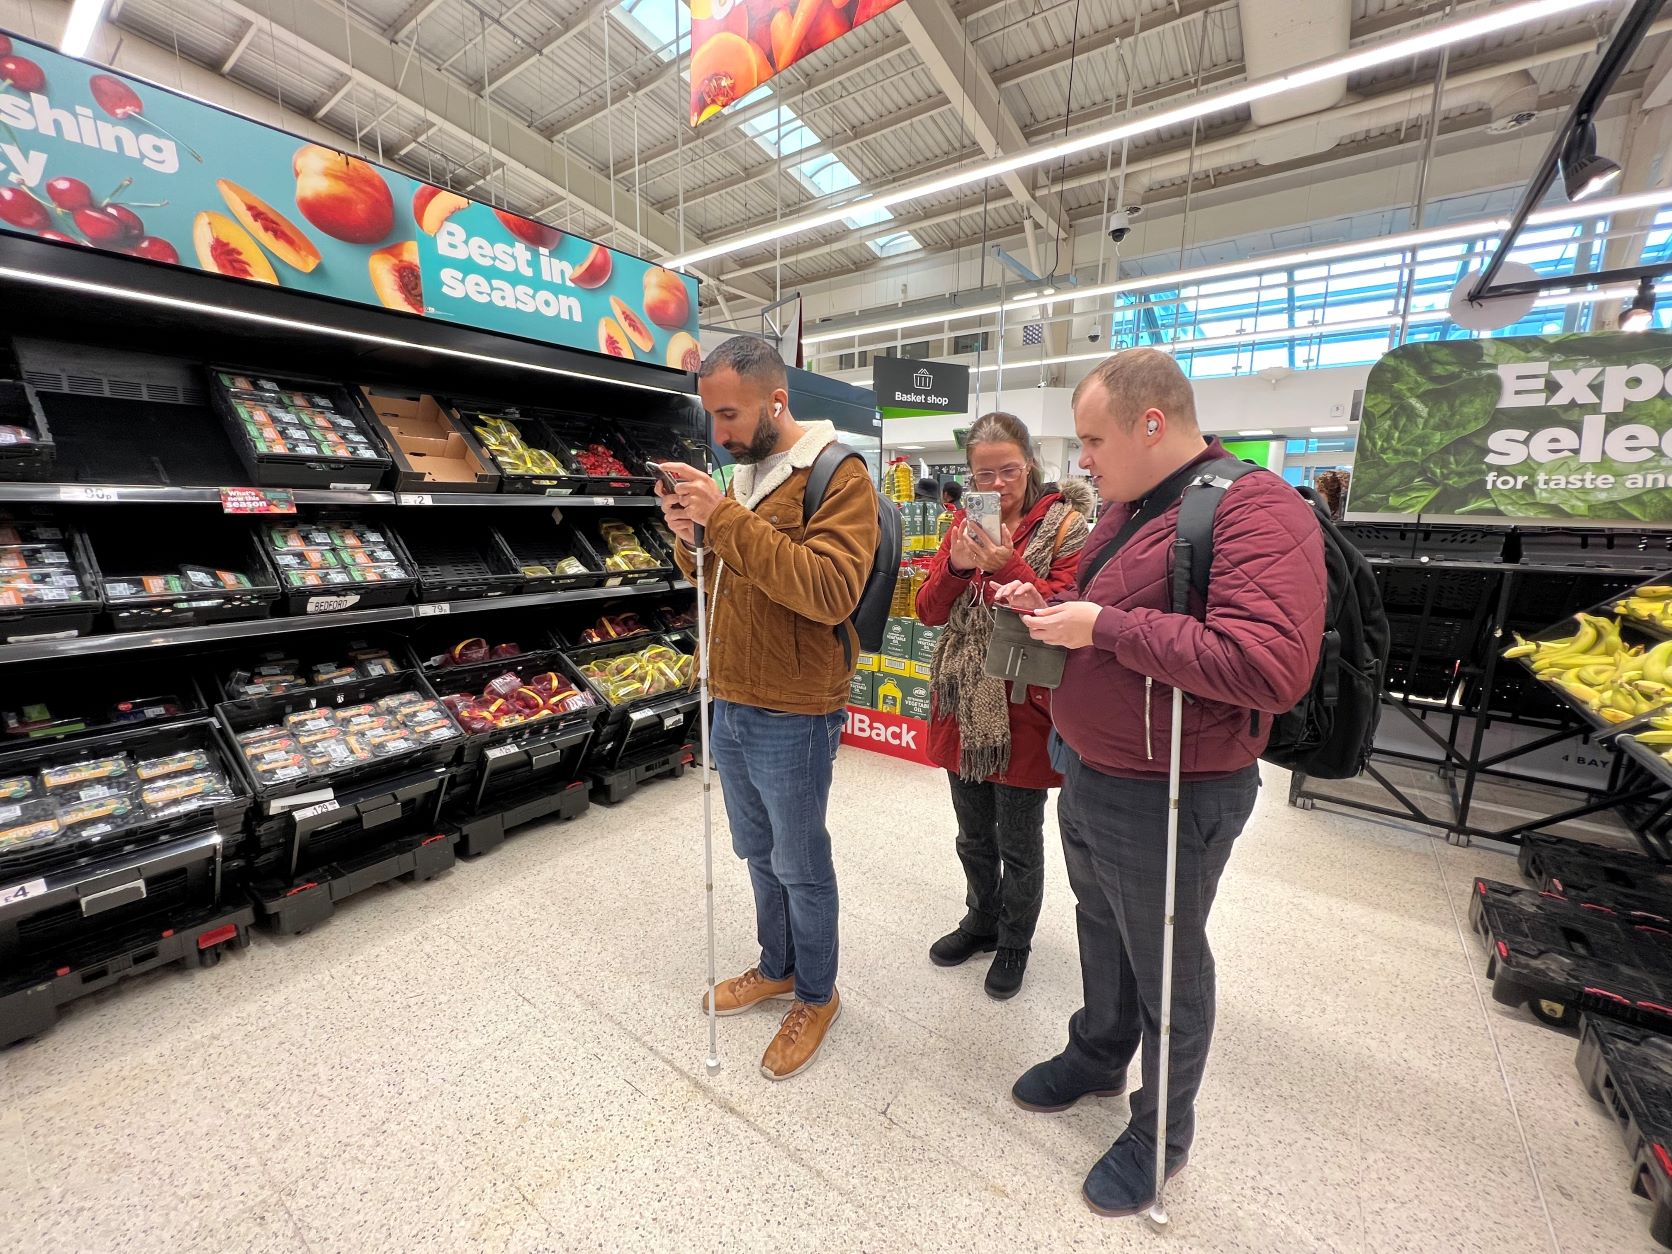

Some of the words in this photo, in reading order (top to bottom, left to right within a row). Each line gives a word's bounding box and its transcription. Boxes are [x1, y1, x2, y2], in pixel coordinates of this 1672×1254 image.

[0, 92, 179, 174] shing
[0, 143, 48, 187] y
[436, 221, 533, 277] Best
[539, 247, 576, 288] in
[440, 267, 582, 322] season
[895, 391, 925, 403] Basket
[927, 394, 949, 406] shop
[1495, 361, 1672, 413] Exp
[1484, 414, 1672, 466] sele
[1485, 472, 1528, 489] for
[1537, 471, 1615, 489] taste
[226, 500, 267, 508] season
[842, 711, 917, 750] lBack
[1577, 756, 1609, 768] BAY
